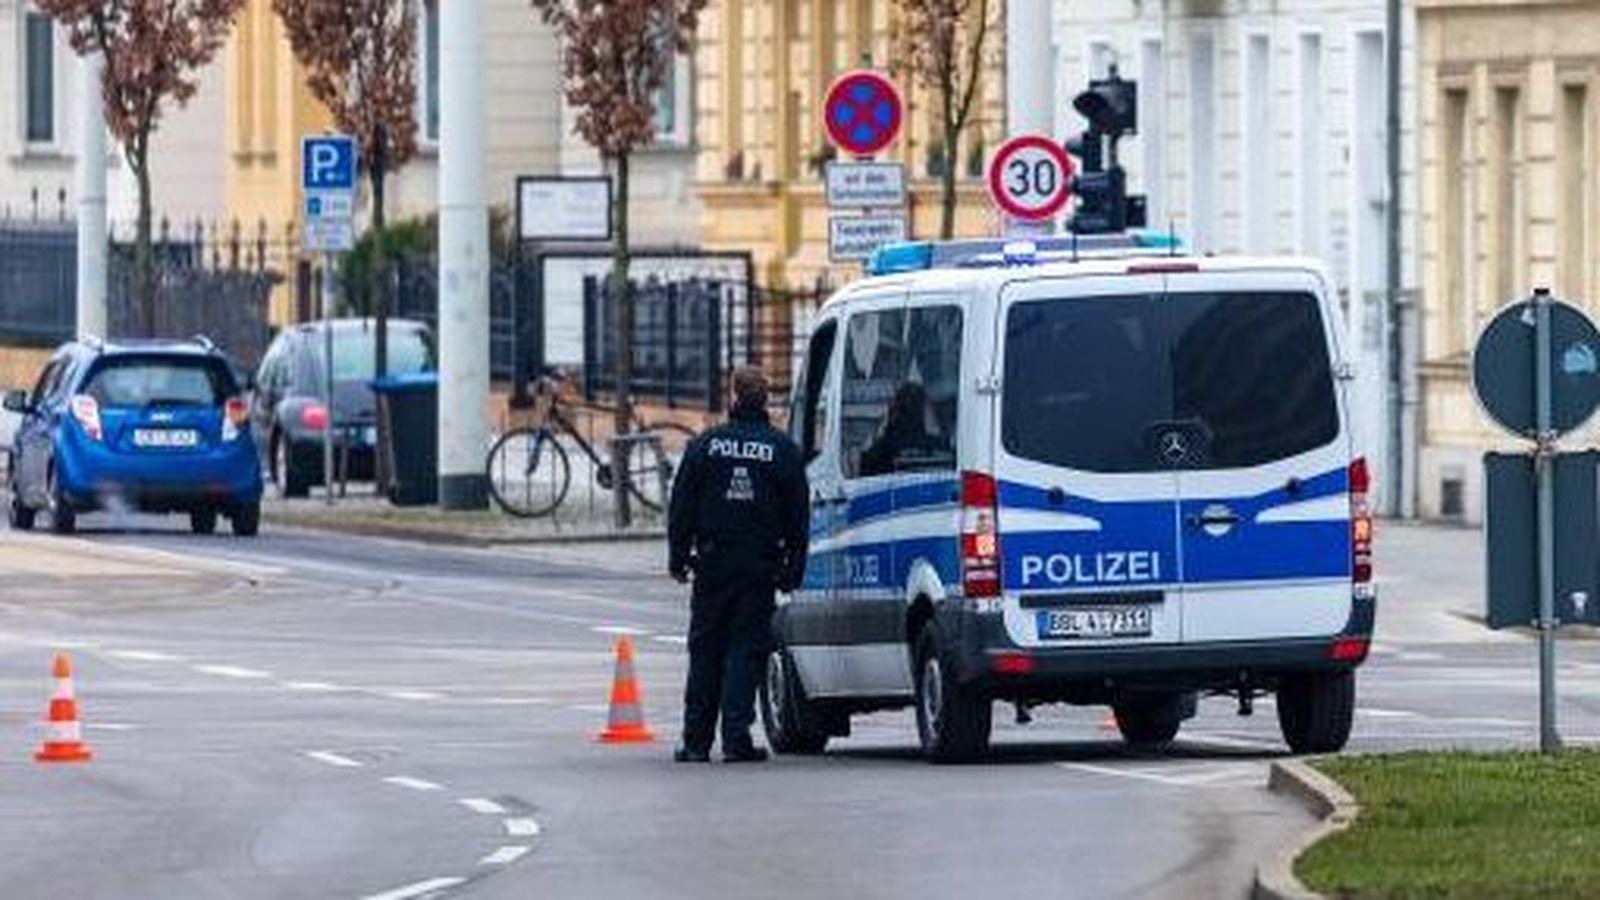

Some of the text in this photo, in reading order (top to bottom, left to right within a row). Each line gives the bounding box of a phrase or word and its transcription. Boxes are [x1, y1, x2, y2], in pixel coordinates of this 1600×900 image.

[312, 144, 339, 182] P
[1008, 159, 1055, 197] 30
[708, 438, 773, 462] POLIZEI
[1021, 551, 1159, 585] POLIZEI
